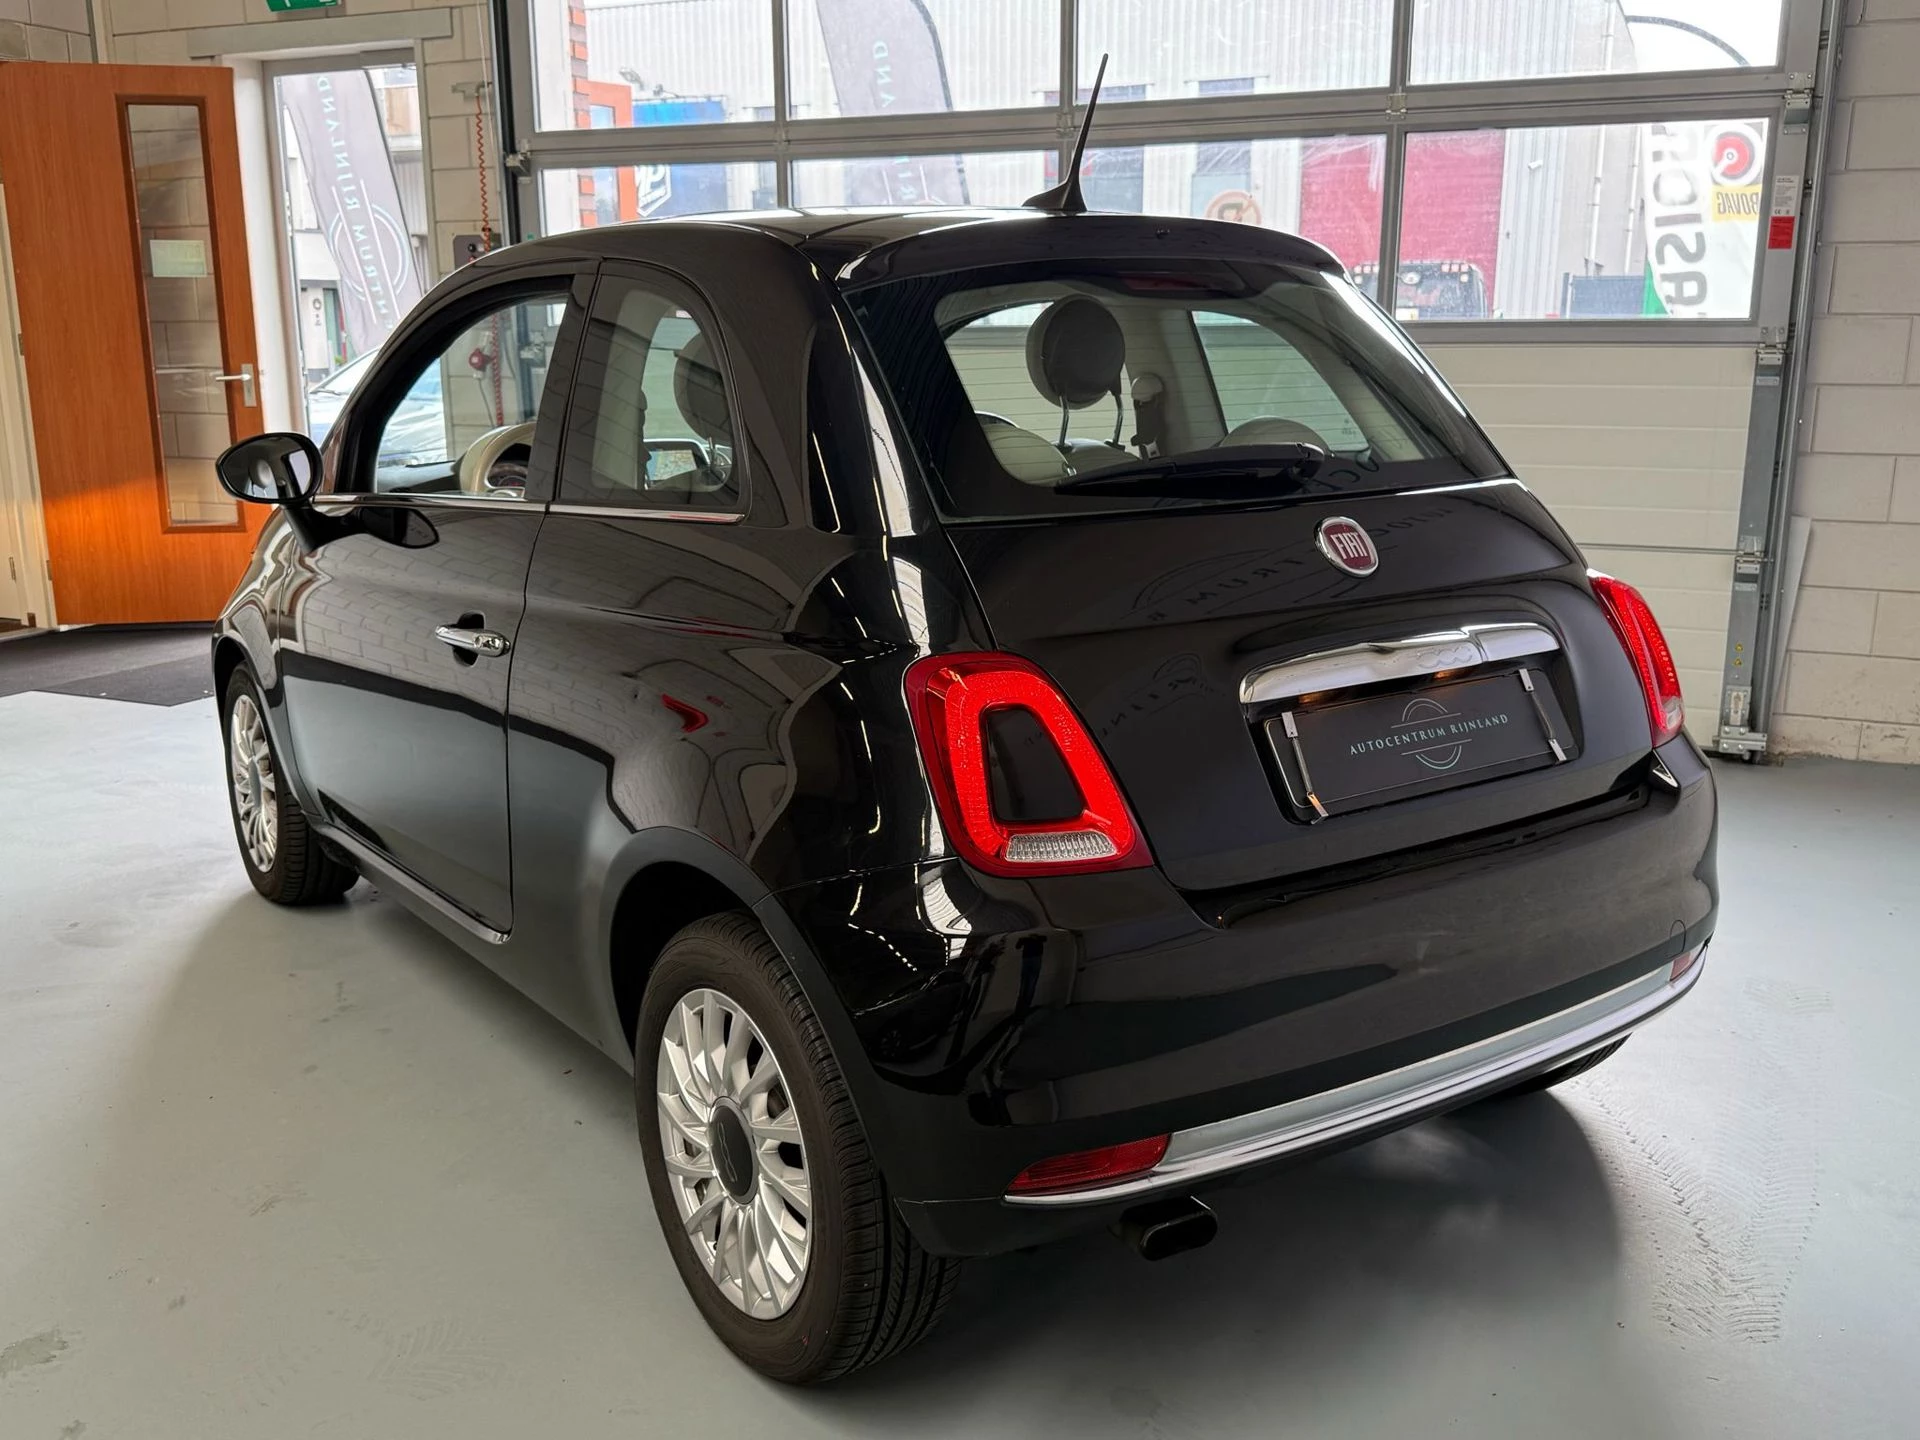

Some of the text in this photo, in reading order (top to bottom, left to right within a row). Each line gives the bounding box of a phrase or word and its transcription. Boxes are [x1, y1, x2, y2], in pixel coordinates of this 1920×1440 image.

[1330, 531, 1368, 560] FIAT
[1350, 713, 1509, 756] AUTOCENTRUM RIJNLAND
